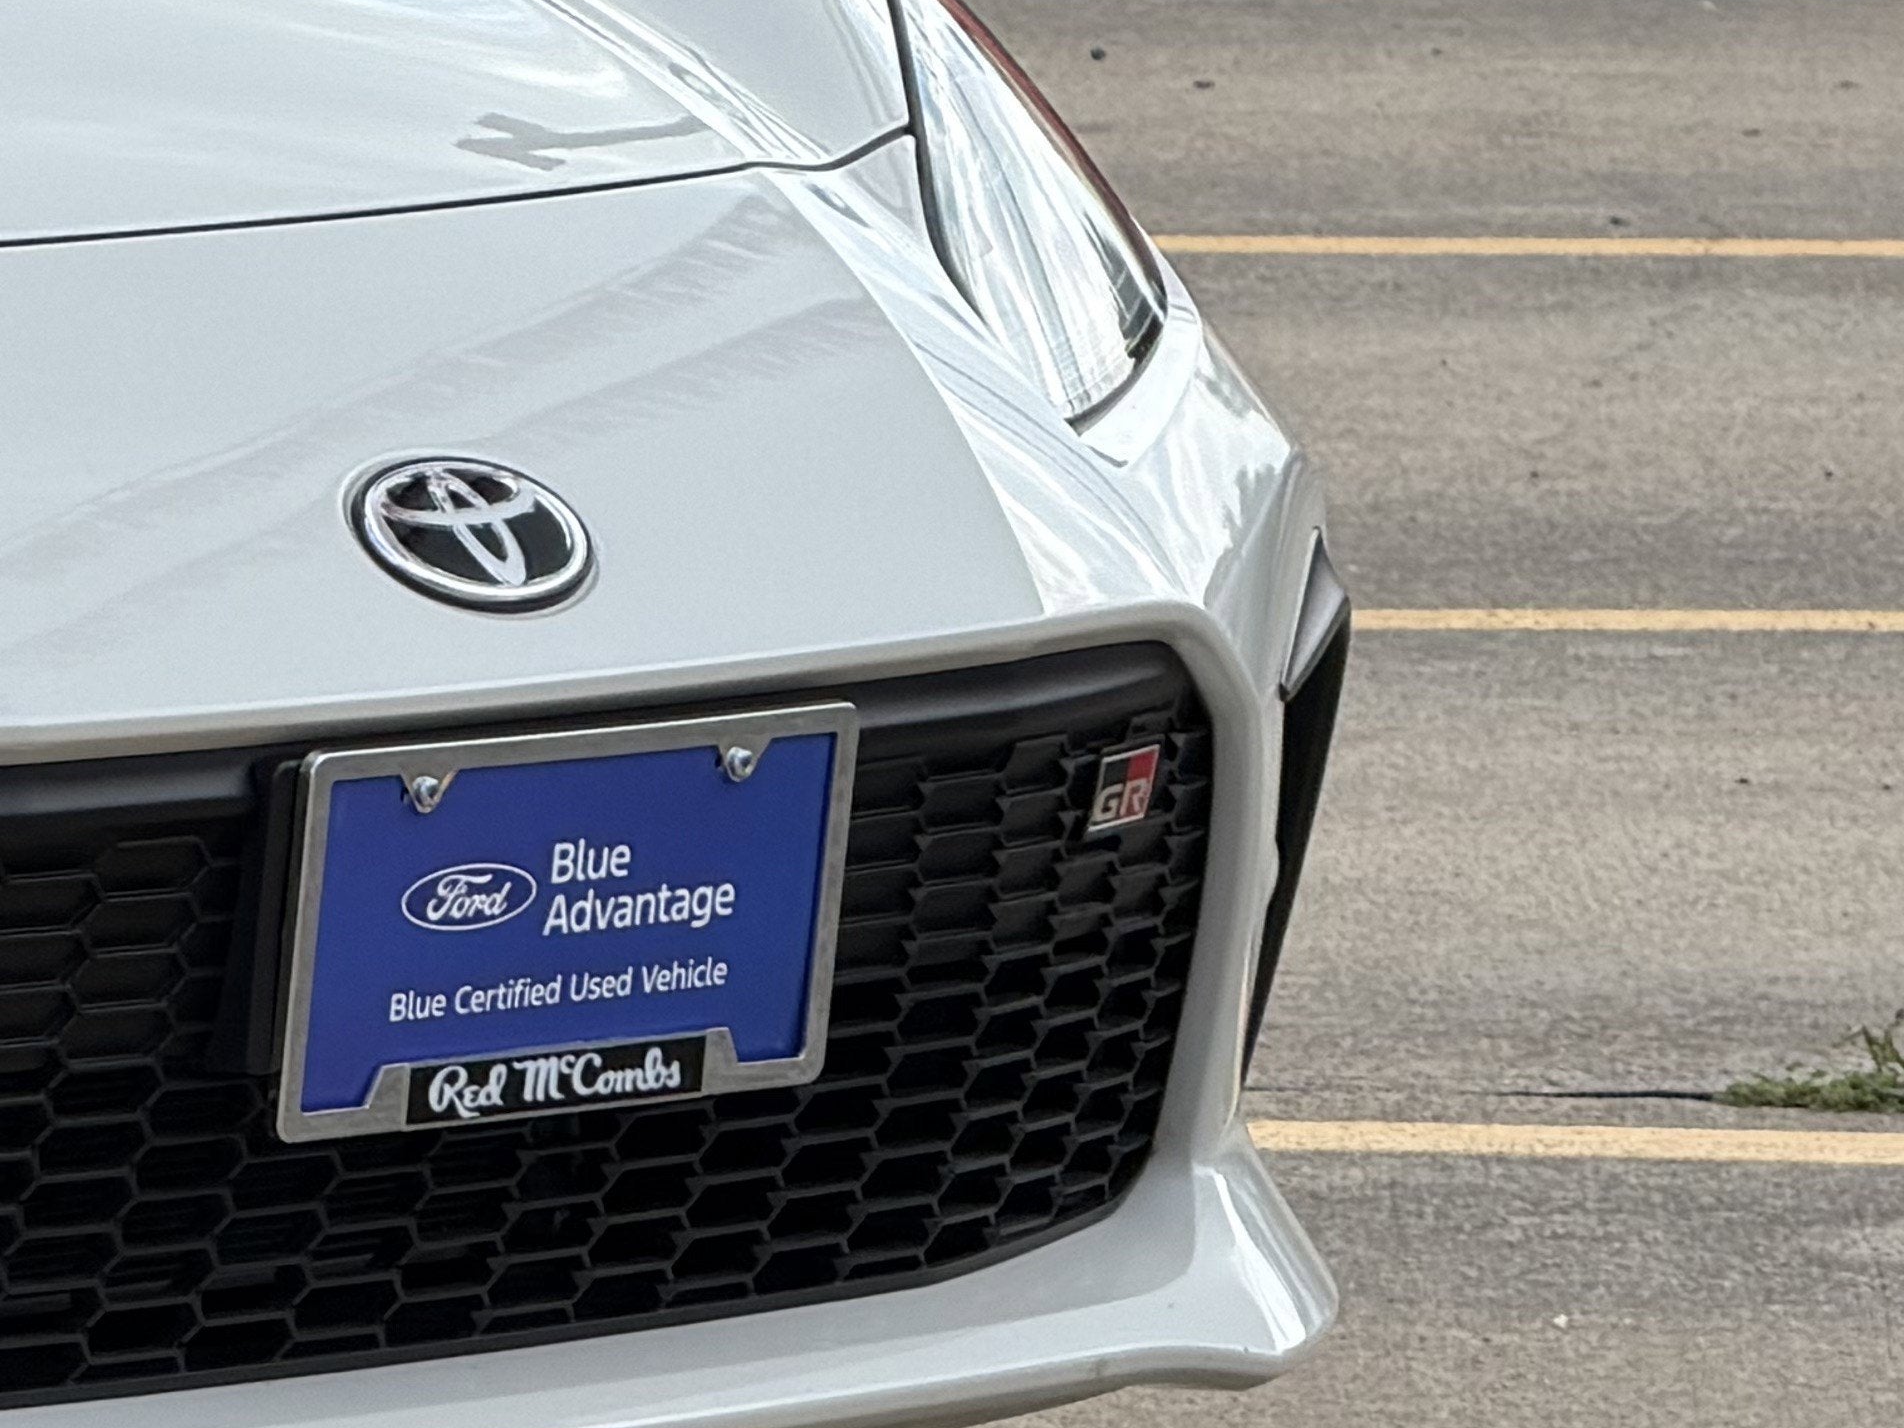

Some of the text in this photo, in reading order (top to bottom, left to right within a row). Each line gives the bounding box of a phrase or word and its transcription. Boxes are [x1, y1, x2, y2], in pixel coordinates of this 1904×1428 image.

[1092, 778, 1151, 822] GR
[550, 837, 632, 884] Blue
[425, 873, 512, 922] Ford
[542, 882, 735, 936] Advantage
[389, 956, 728, 1022] Blue Certified Used Vehicle
[427, 1047, 682, 1118] Red McCombs
